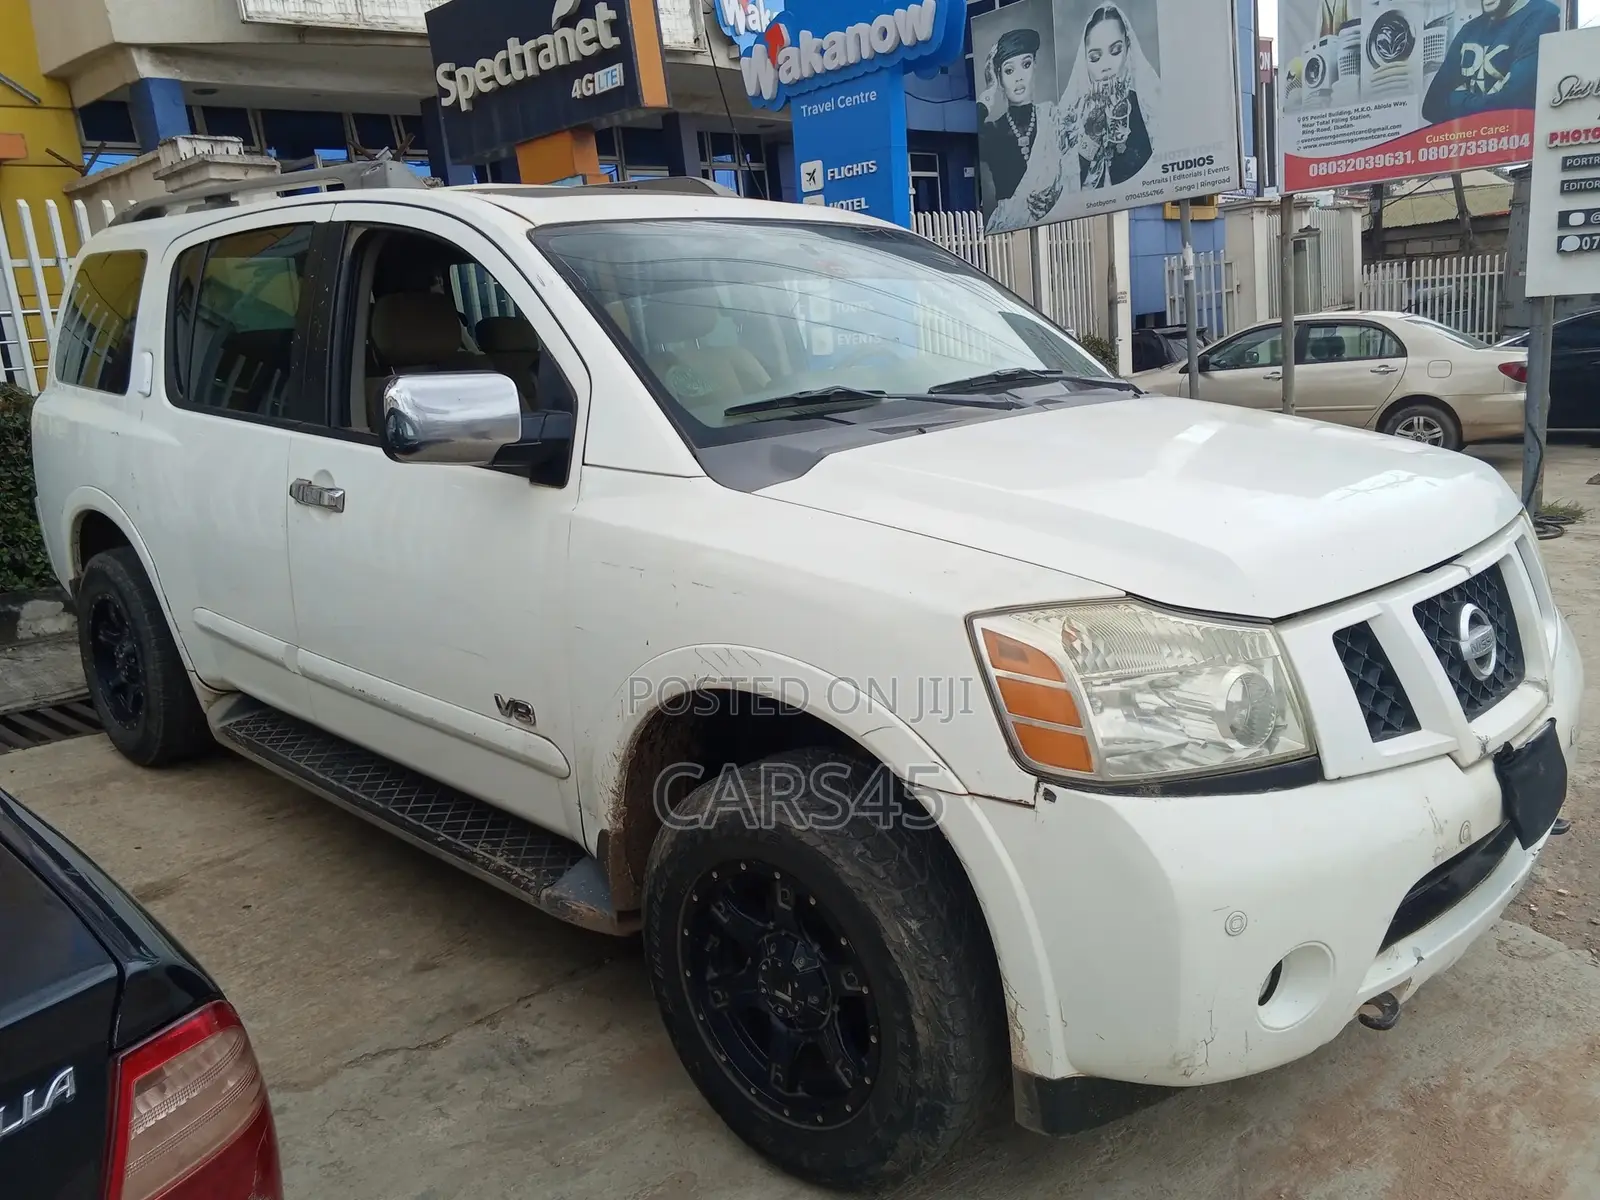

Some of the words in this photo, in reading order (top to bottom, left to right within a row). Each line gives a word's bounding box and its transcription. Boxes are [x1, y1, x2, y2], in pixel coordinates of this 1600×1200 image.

[435, 2, 621, 112] Spectranet
[740, 0, 936, 100] Wakanow
[801, 97, 835, 118] Travel
[837, 90, 877, 108] Centre
[1373, 102, 1392, 111] Abiola
[1425, 128, 1478, 144] Customer
[1480, 125, 1510, 137] Care:
[1161, 154, 1215, 174] STUDIOS
[1309, 150, 1415, 177] 08032039631,
[1418, 133, 1531, 163] 08027338404
[827, 160, 878, 181] FLIGHTS
[1141, 176, 1169, 187] Portraits
[1172, 170, 1203, 182] Editorials
[1207, 164, 1230, 176] Events
[1200, 176, 1231, 188] Ringroad
[494, 692, 536, 726] V8
